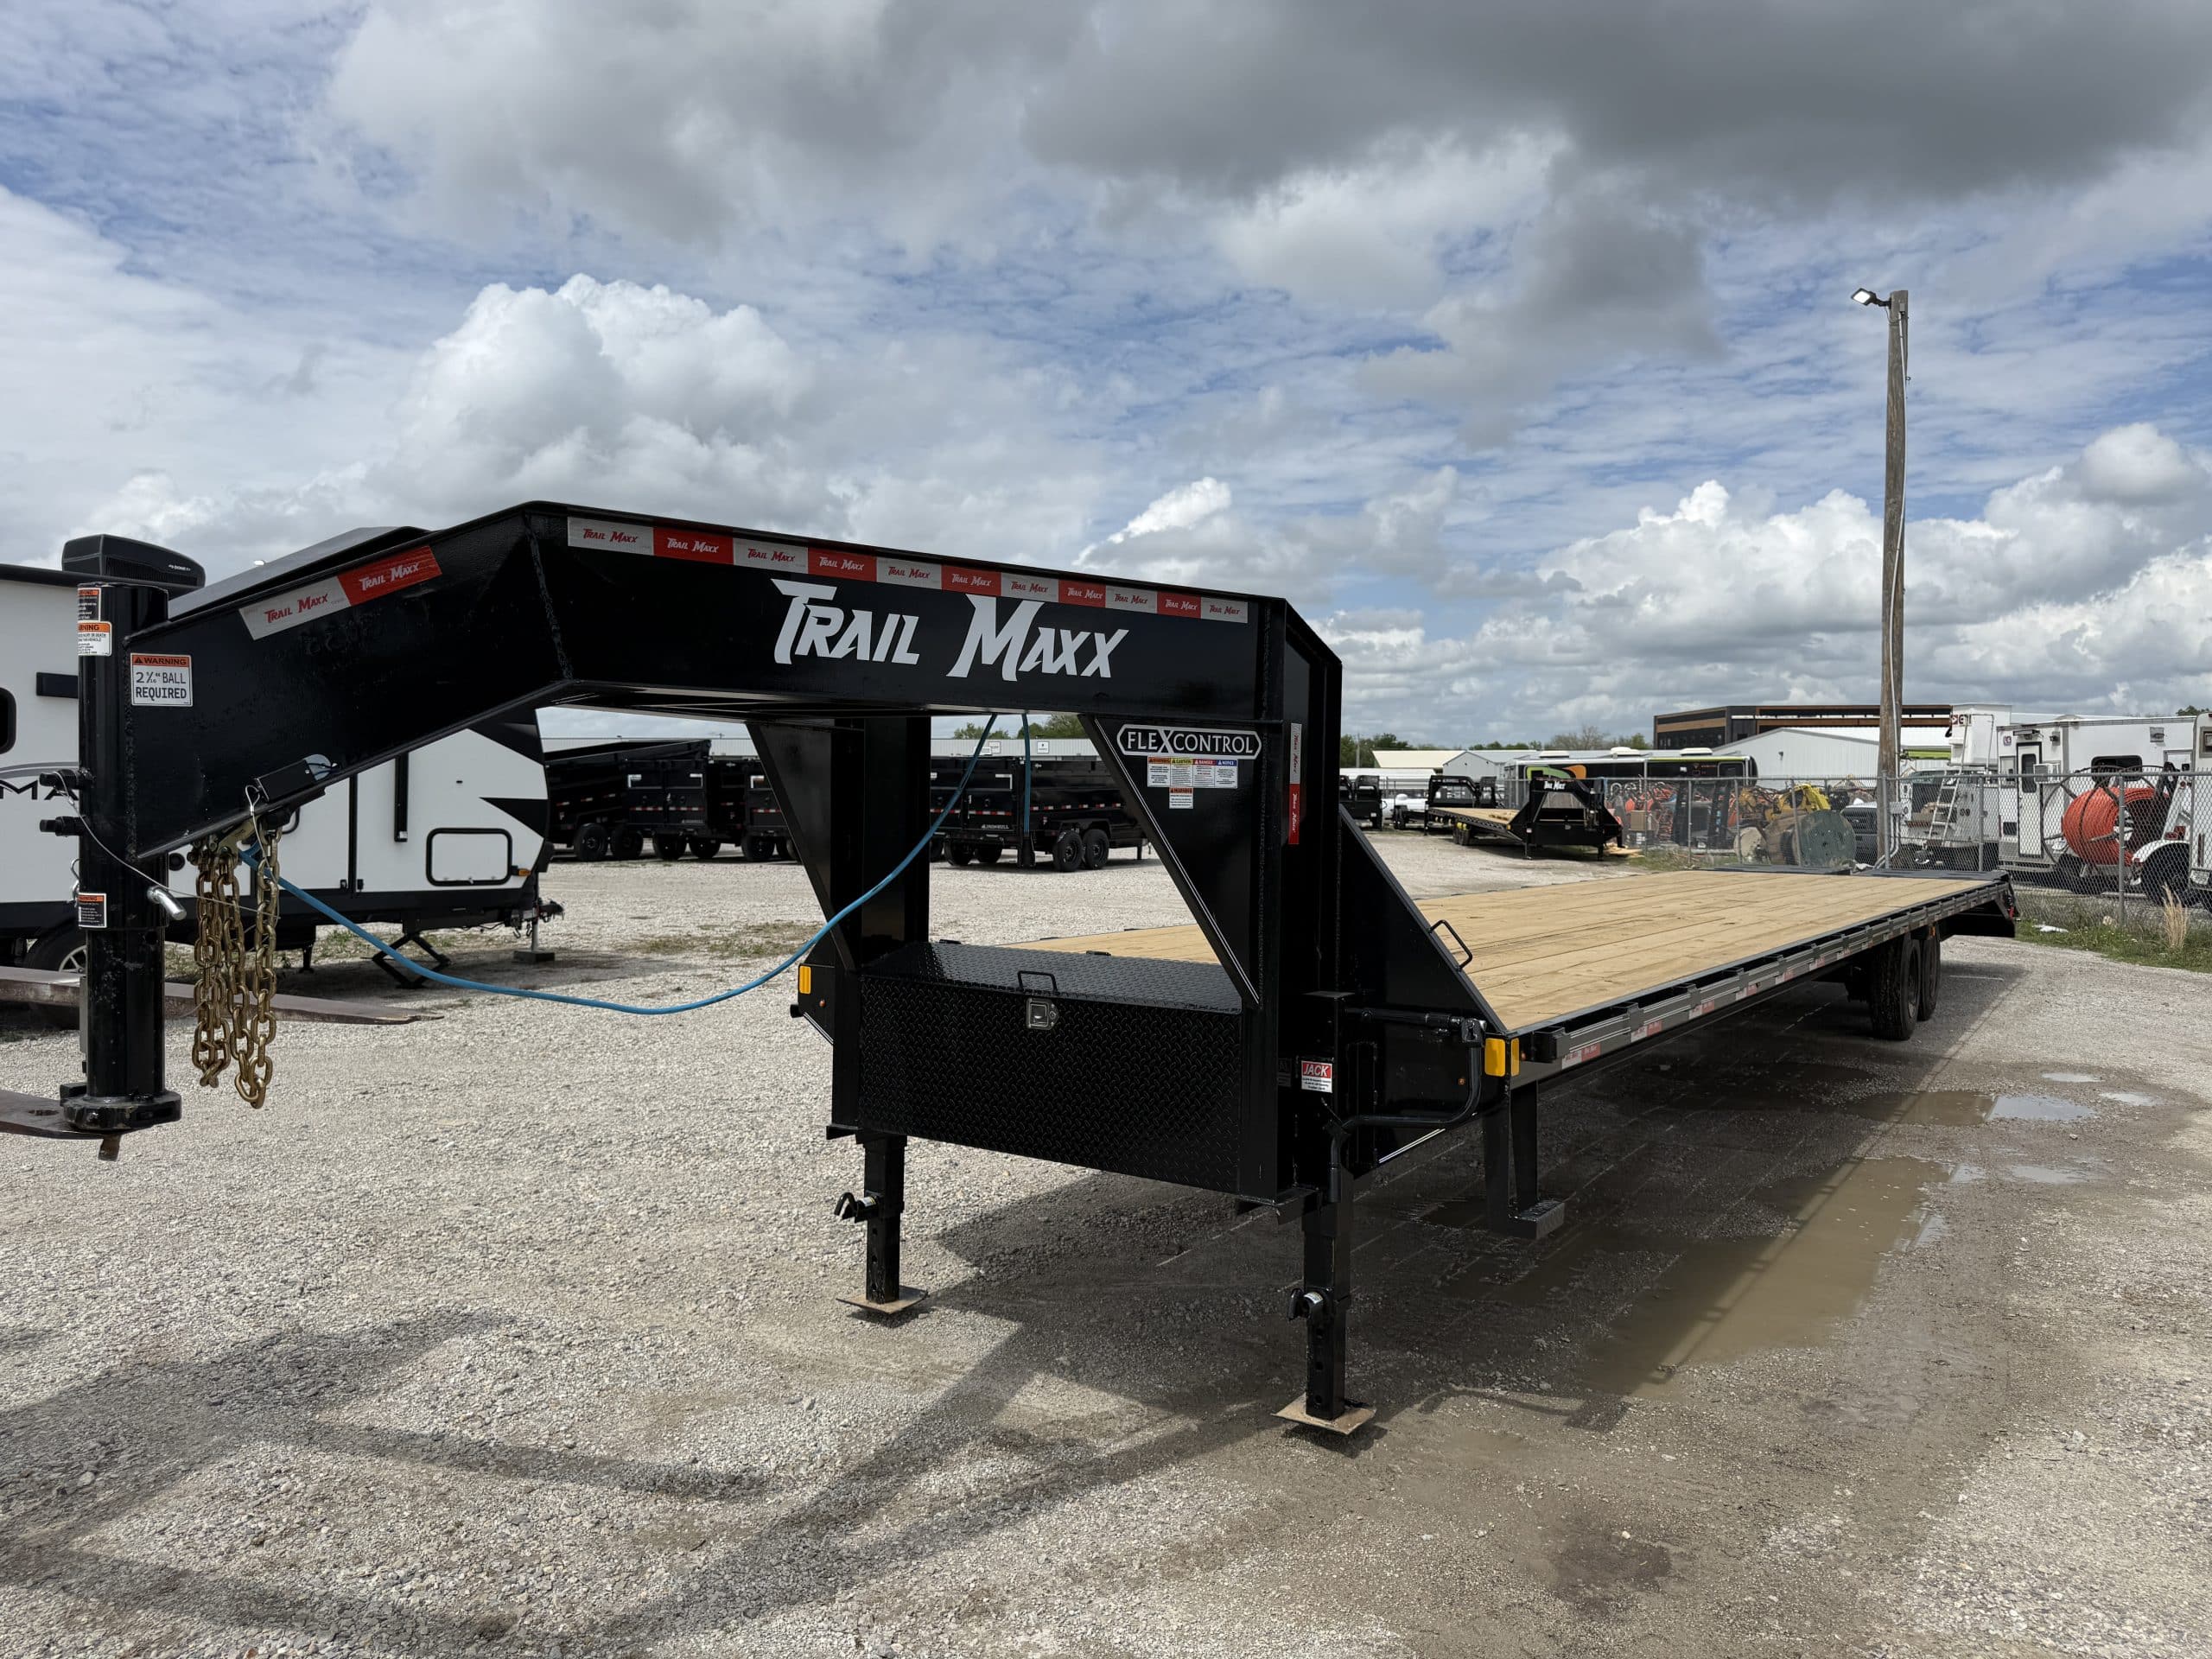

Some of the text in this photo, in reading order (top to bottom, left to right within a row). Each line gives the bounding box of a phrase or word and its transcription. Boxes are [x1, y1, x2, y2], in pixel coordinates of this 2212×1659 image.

[582, 528, 639, 543] TRAIL MAXX
[667, 537, 719, 553] TRAIL MAXX
[747, 548, 795, 563] TRAIL MAXX
[818, 556, 864, 571] TRAIL MAXX
[359, 562, 420, 591] TRAIL MAXX
[264, 593, 328, 623] TRAIL MAXX
[771, 578, 1128, 681] TRAIL MAXX
[143, 657, 187, 665] WARNING
[162, 672, 187, 684] BALL
[136, 687, 187, 701] REQUIRED
[1127, 728, 1253, 753] FLEXCONTROL
[1304, 1065, 1328, 1077] JACK
